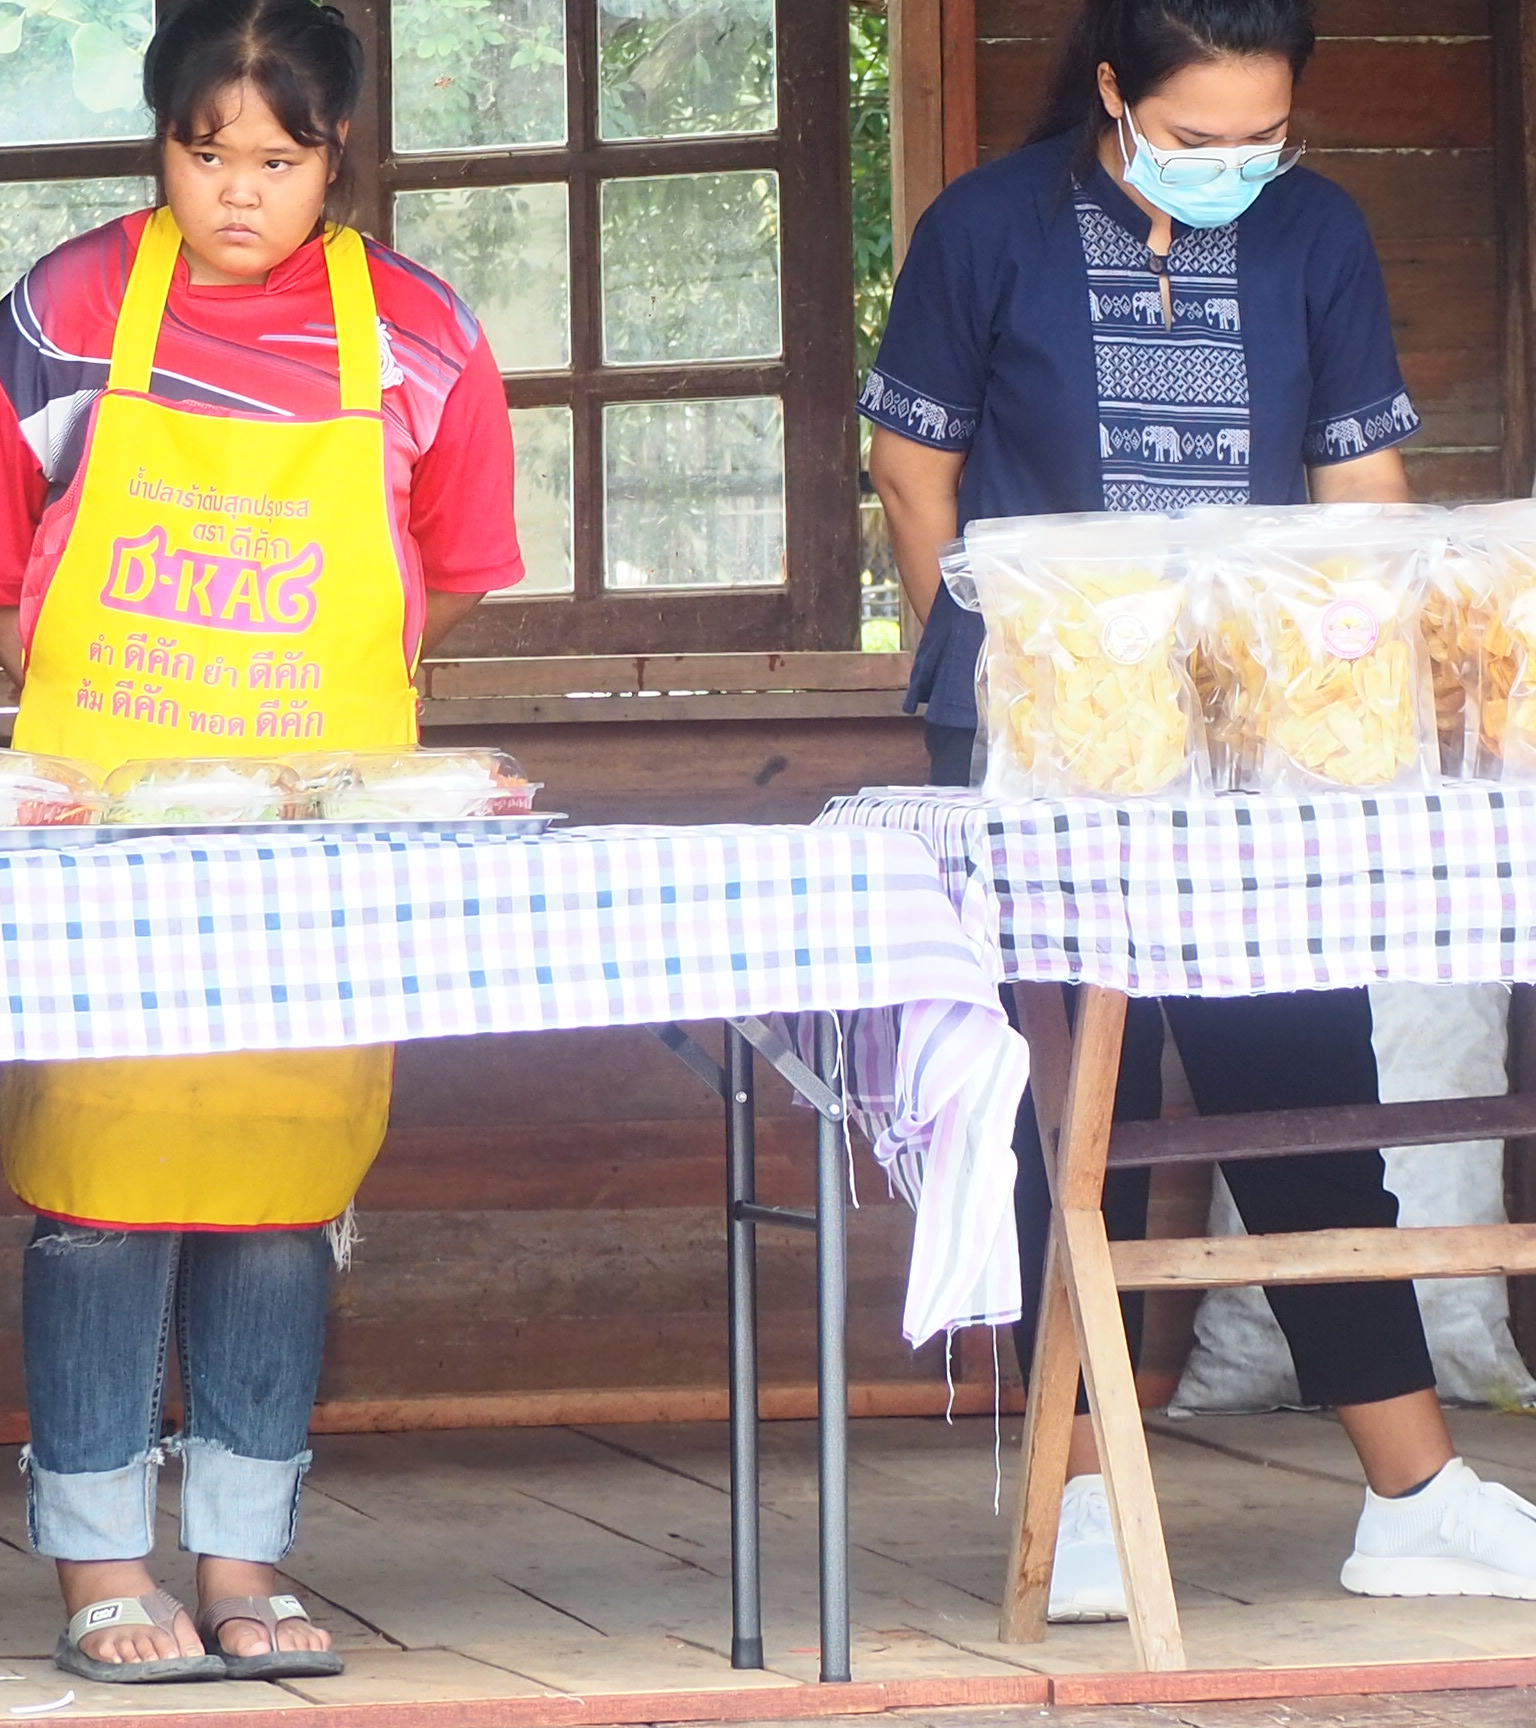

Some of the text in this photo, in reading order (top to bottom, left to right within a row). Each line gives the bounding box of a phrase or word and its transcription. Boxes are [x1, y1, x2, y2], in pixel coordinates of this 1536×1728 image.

[192, 522, 225, 543] ตรา
[89, 633, 320, 690] ตำ ดีคัก ยำ ดีคัก
[76, 678, 324, 738] ต้ม ดีคัก ทอด ดีคัก
